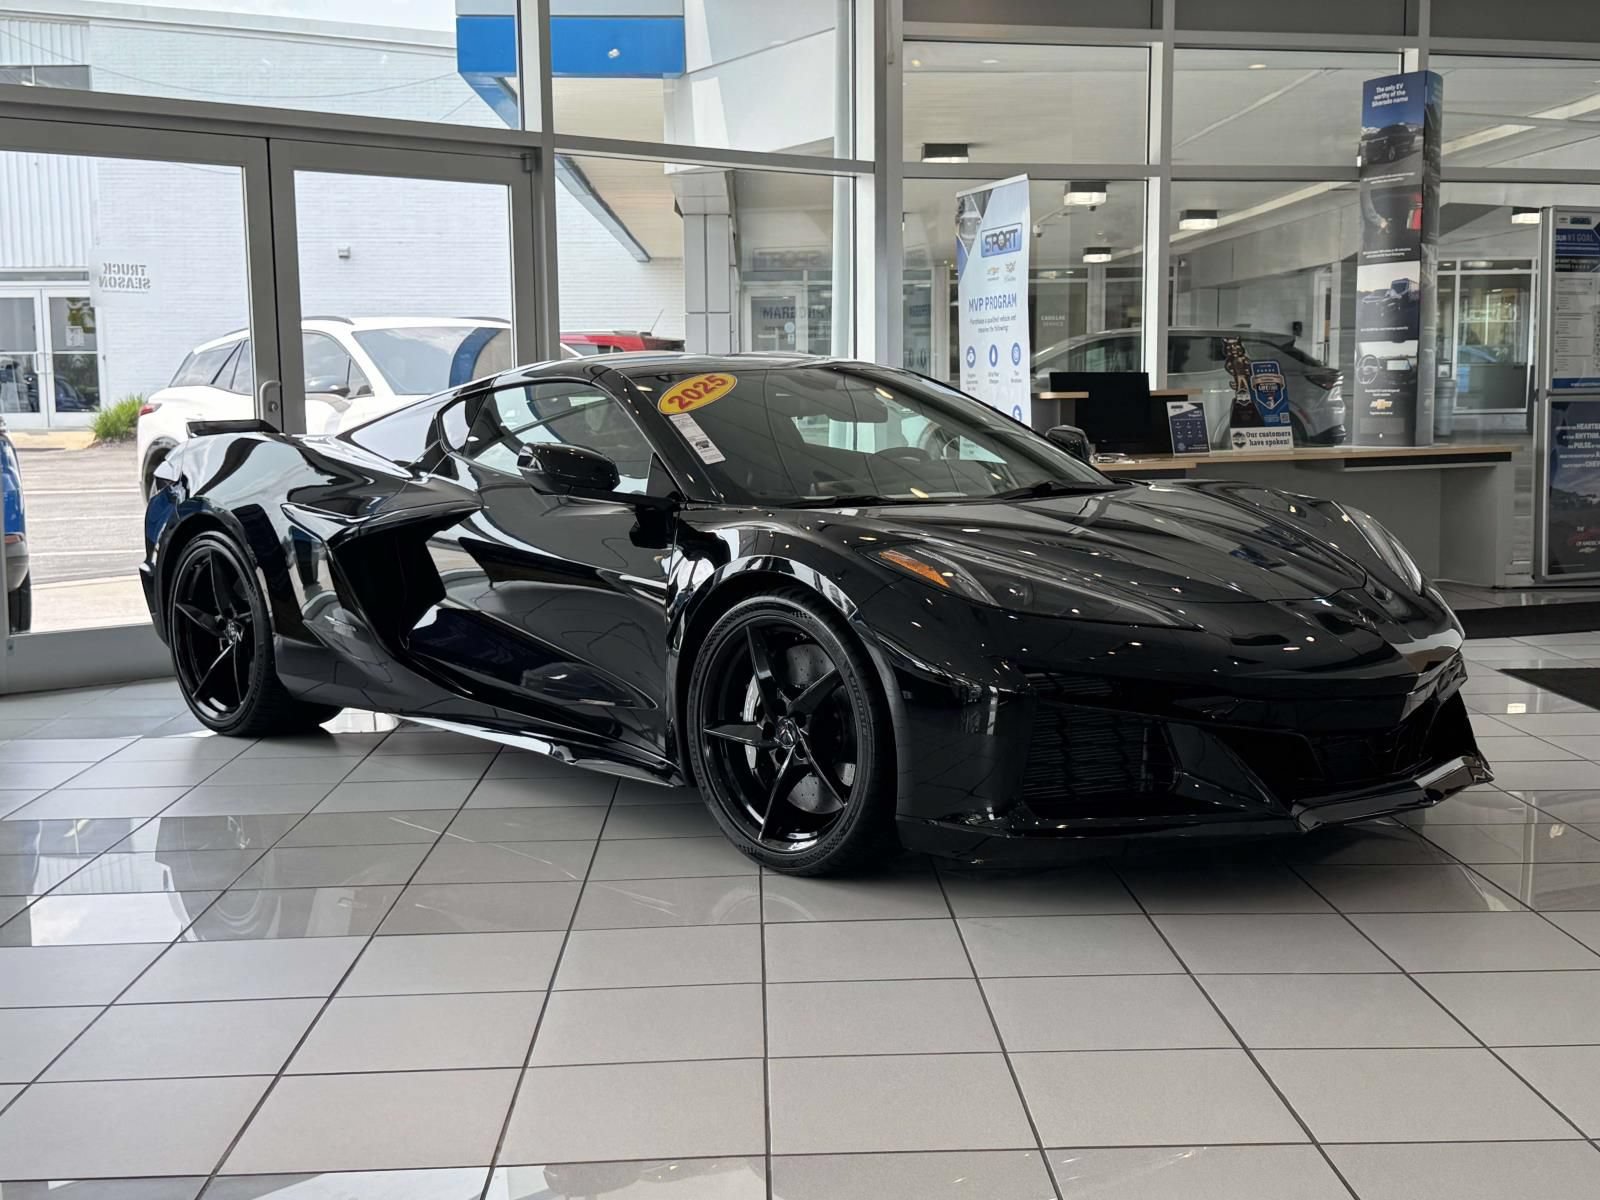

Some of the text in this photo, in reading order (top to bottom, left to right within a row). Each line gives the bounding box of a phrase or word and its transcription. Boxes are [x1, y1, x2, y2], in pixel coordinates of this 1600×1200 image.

[985, 228, 1018, 252] SPORT
[968, 292, 1017, 312] MVP PROGRAM
[668, 375, 728, 410] 2025
[1265, 439, 1290, 447] spoken!
